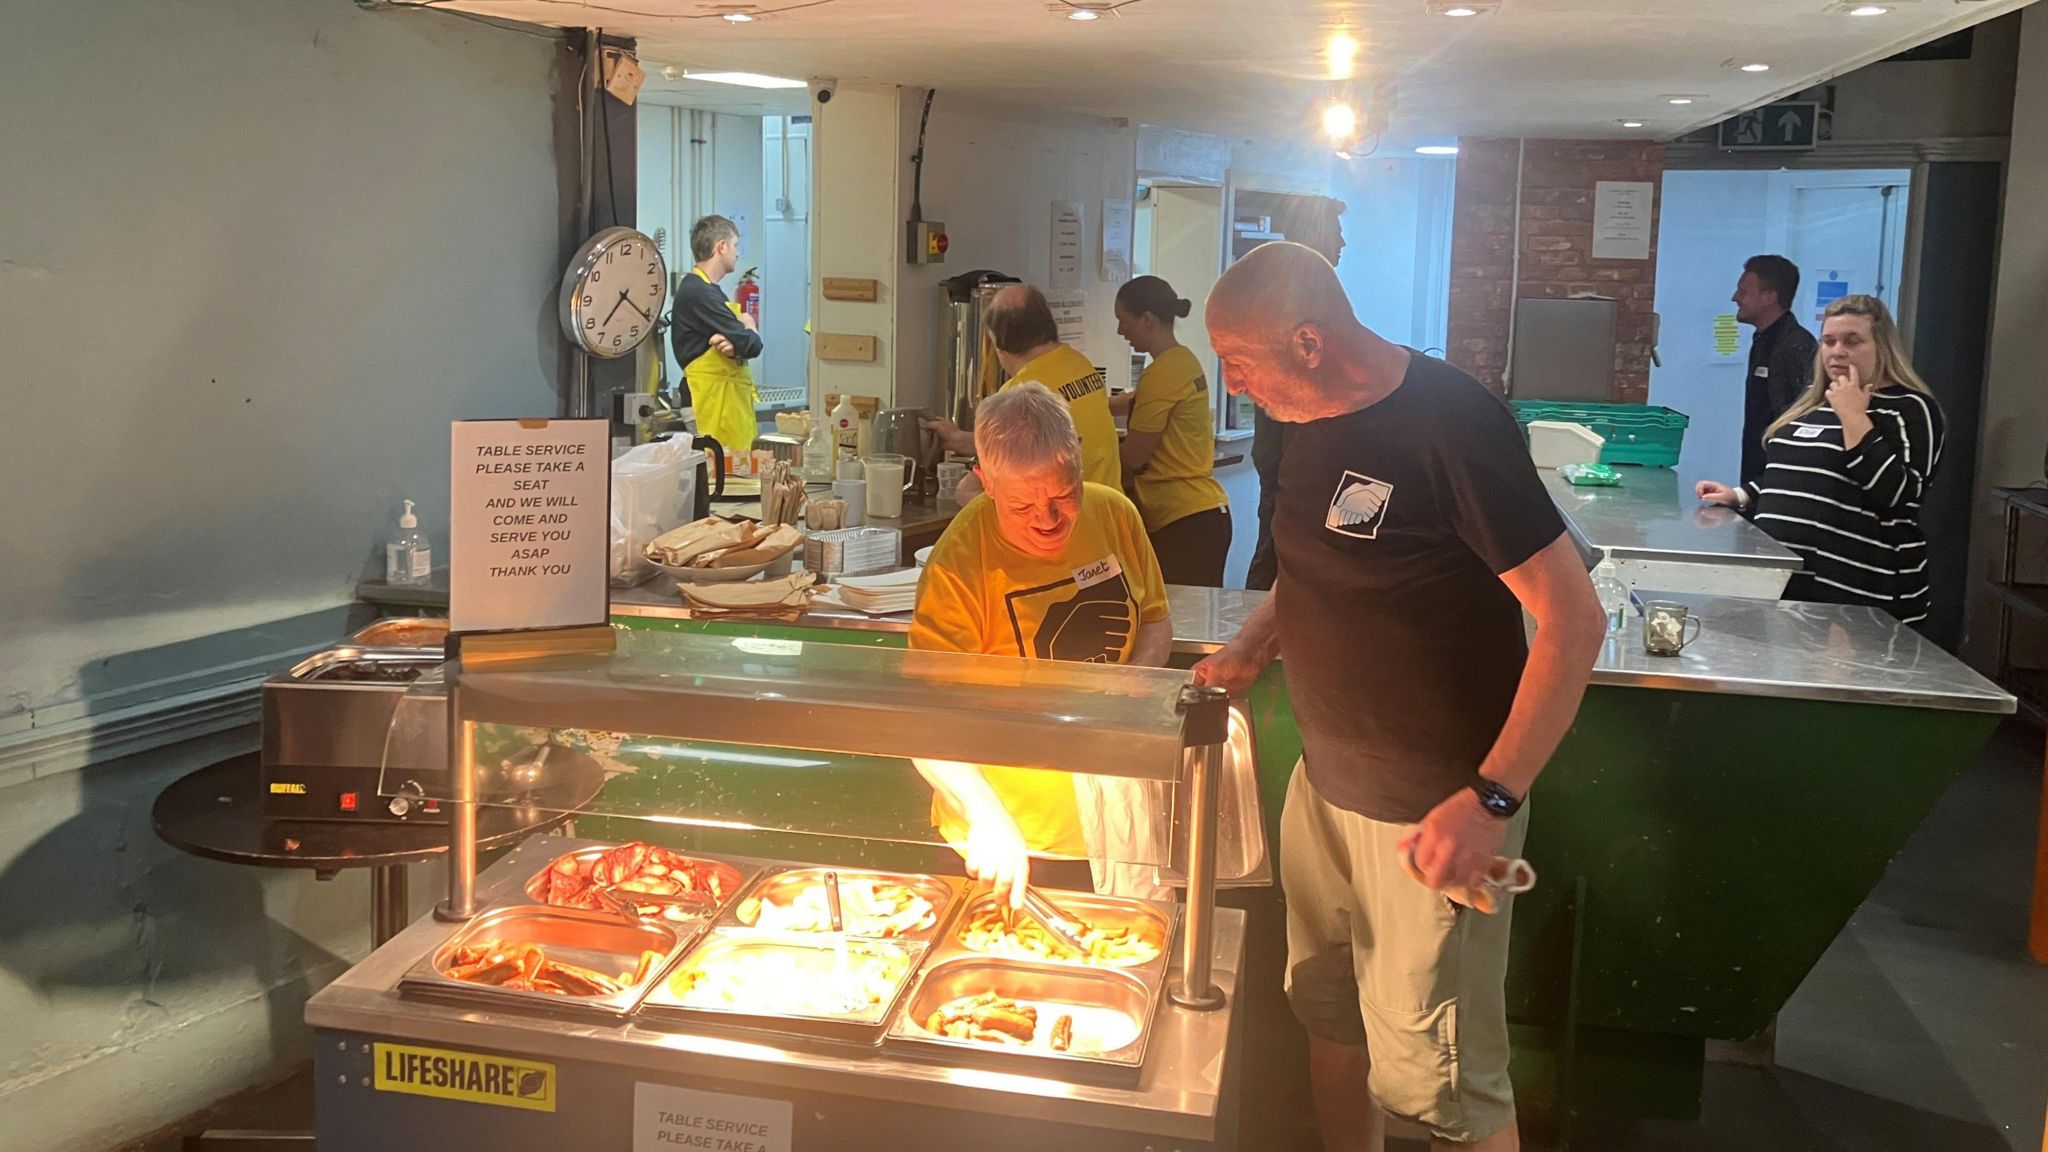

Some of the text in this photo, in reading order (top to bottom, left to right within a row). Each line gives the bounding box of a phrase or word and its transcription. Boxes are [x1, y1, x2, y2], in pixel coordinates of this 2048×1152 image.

[620, 244, 632, 256] 12
[640, 248, 644, 259] 1
[606, 252, 614, 264] 11
[647, 263, 656, 275] 2
[591, 271, 600, 283] 10
[649, 284, 659, 296] 3
[583, 295, 592, 307] 9
[585, 318, 595, 329] 8
[629, 325, 639, 337] 5
[597, 332, 605, 344] 7
[613, 335, 622, 347] 6
[476, 444, 586, 457] TABLE SERVICE
[476, 461, 585, 474] PLEASE TAKE A
[513, 479, 550, 491] SEAT
[485, 496, 579, 509] AND WE WILL
[493, 513, 568, 526] COME AND
[490, 530, 571, 543] SERVE YOU
[511, 548, 550, 560] ASAP
[489, 564, 571, 577] THANK YOU
[1078, 561, 1110, 581] Janet
[385, 1051, 515, 1096] LIFESHARE
[658, 1111, 769, 1137] TABLE SERVICE
[657, 1130, 713, 1149] PLEASE
[717, 1138, 754, 1152] TAKE
